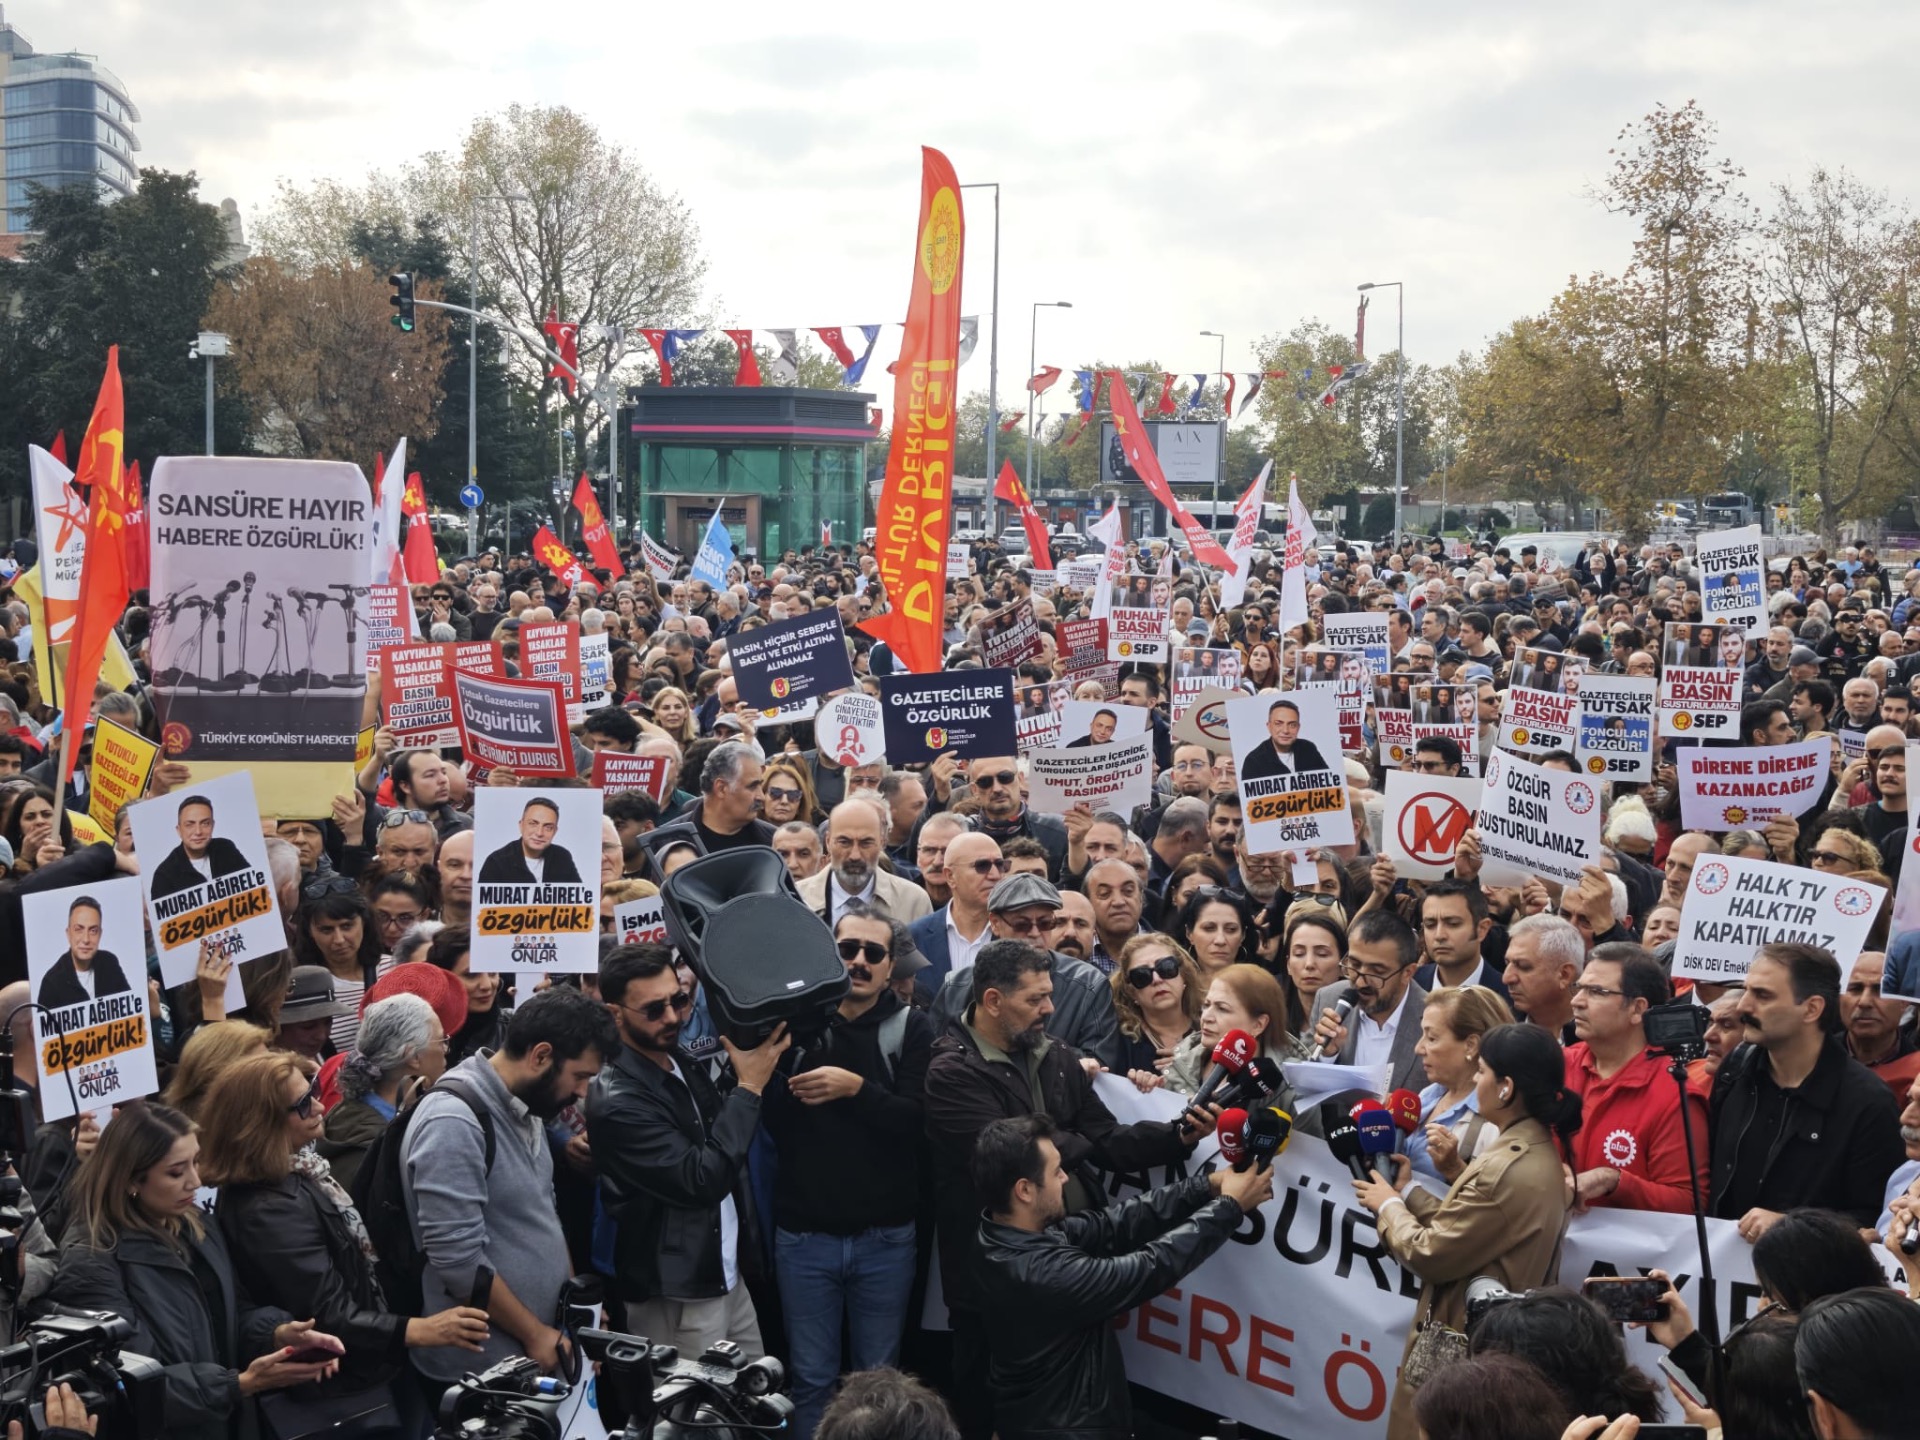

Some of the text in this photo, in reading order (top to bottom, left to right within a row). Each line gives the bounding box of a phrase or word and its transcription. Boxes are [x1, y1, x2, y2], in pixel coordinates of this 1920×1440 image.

[158, 490, 365, 522] SANSÜRE HAYIR
[157, 525, 364, 550] HABERE ÖZGÜRLÜK!
[1700, 544, 1759, 561] GAZETECİLER
[1702, 553, 1760, 573] TUTSAK
[1705, 584, 1759, 599] FONCULAR
[1711, 595, 1756, 611] ÖZGÜR!
[1112, 609, 1167, 622] MUHALİF
[986, 616, 1032, 648] TUTUKLU
[1116, 621, 1162, 634] BASIN
[1326, 625, 1388, 635] GAZETECİLER
[527, 638, 567, 652] YASAKLAR
[732, 619, 837, 657] BASIN, HİÇBİR SEBEPLE
[1327, 633, 1387, 646] TUTSAK
[528, 650, 567, 664] YENİLECEK
[739, 633, 836, 668] BASKI VE ETKİ ALTINA
[1133, 644, 1159, 655] SEP
[393, 660, 442, 675] YASAKLAR
[534, 663, 558, 675] BASIN
[766, 651, 814, 672] ALINAMAZ
[394, 672, 444, 688] YENİLECEK
[1074, 669, 1096, 681] EHP
[1666, 669, 1740, 685] MUHALİF
[404, 687, 434, 700] BASIN
[460, 686, 540, 711] Tutsak Gazetecilere
[581, 691, 605, 704] SEP
[890, 685, 1004, 706] GAZETECİLERE
[1510, 689, 1577, 711] MUHALİF
[1579, 691, 1653, 702] GAZETECİLER
[1671, 684, 1733, 701] BASIN
[391, 698, 450, 716] ÖZGÜRLÜĞÜ
[906, 703, 992, 724] ÖZGÜRLÜK
[1513, 702, 1570, 725] BASIN
[1582, 700, 1652, 715] TUTSAK
[1663, 701, 1740, 711] SUSTURULAMAZ!
[463, 698, 543, 734] Özgürlük
[1504, 715, 1575, 734] SUSTURULAMAZ!
[1693, 713, 1728, 728] SEP
[199, 731, 361, 745] TÜRKİYE KOMÜNİST HAREKETİ
[403, 734, 438, 747] EHP
[1530, 732, 1562, 748] SEP
[1581, 727, 1648, 739] FONCULAR
[105, 739, 138, 766] TUTUKLU
[1587, 737, 1643, 752] ÖZGÜR!
[521, 751, 558, 769] DURUŞ
[1034, 752, 1149, 774] VURGUNCULAR DIŞARIDA!
[1036, 744, 1148, 766] GAZETECİLER İÇERİDE,
[1692, 753, 1818, 774] DİRENE DİRENE
[1608, 759, 1640, 773] SEP
[605, 772, 651, 784] YASAKLAR
[1045, 763, 1143, 788] UMUT, ÖRGÜTLÜ
[1244, 771, 1341, 798] MURAT AĞIREL'e
[1507, 766, 1551, 801] ÖZGÜR
[1064, 782, 1124, 797] BASINDA!
[1696, 775, 1815, 796] KAZANACAĞIZ
[1251, 789, 1341, 819] özgürlük!
[1508, 796, 1548, 824] BASIN
[1280, 827, 1320, 842] ONLAR
[1478, 809, 1589, 860] SUSTURULAMAZ.
[155, 869, 266, 920] MURAT AĞIREL'e
[479, 883, 593, 905] MURAT AĞIREL'e
[1735, 872, 1827, 902] HALK TV
[164, 889, 268, 944] özgürlük!
[482, 906, 592, 934] özgürlük!
[1728, 897, 1817, 926] HALKTIR
[511, 948, 558, 965] ONLAR
[1683, 953, 1702, 969] DİSK
[1705, 958, 1723, 972] DEV
[40, 995, 143, 1038] MURAT AĞIREL'e
[46, 1022, 145, 1069] özgürlük!
[1224, 1048, 1245, 1066] anka
[78, 1074, 121, 1099] ONLAR
